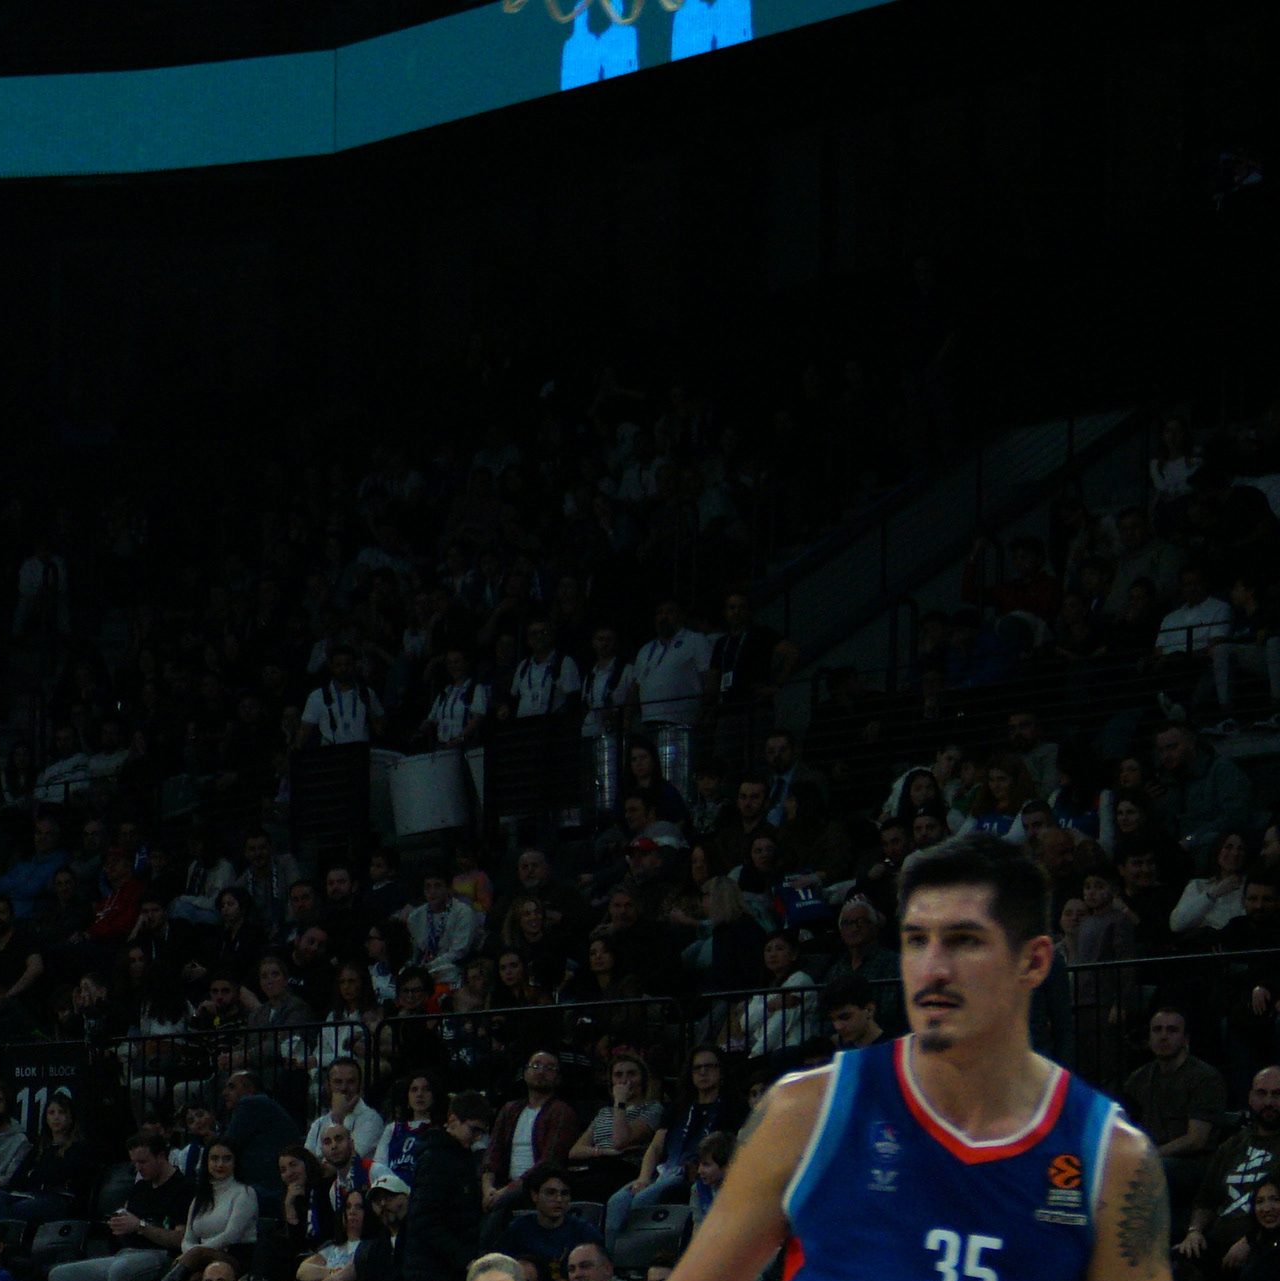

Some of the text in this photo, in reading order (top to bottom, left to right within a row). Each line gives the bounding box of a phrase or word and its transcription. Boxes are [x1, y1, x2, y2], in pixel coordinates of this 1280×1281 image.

[15, 1066, 76, 1078] BLOK BLOCK
[16, 1085, 73, 1136] 11
